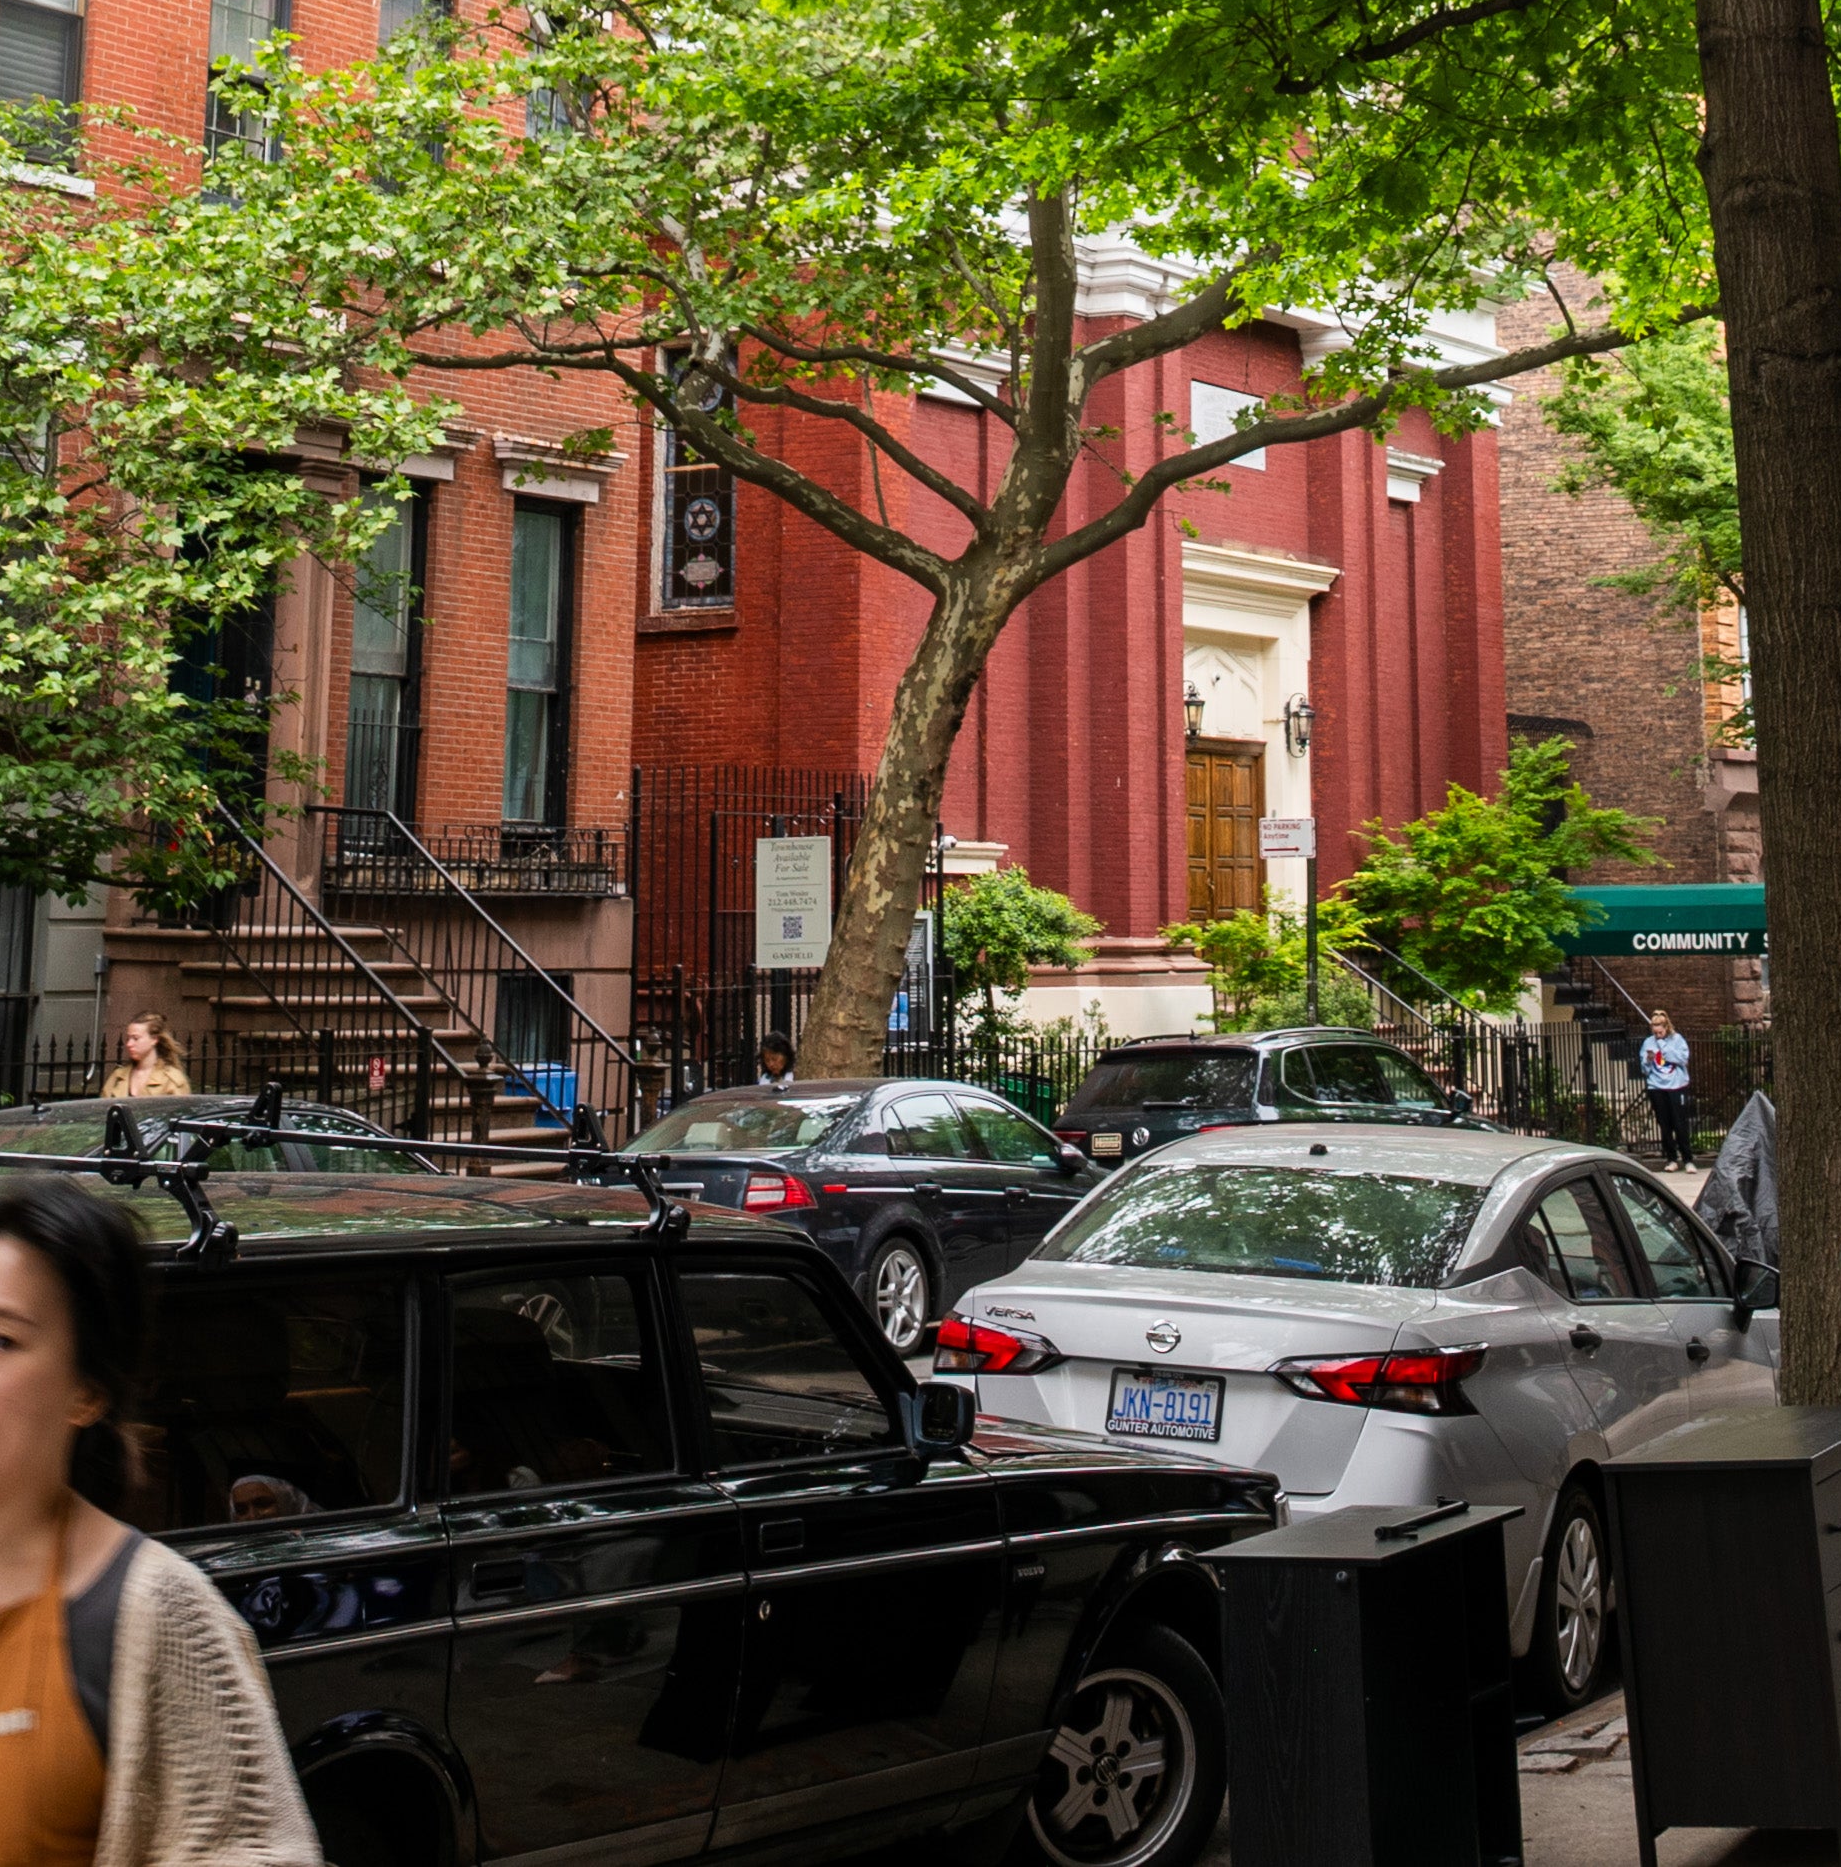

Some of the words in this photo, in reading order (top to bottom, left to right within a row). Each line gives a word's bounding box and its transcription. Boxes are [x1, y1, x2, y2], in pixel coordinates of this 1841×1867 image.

[1632, 933, 1749, 951] COMMUNITY
[984, 1305, 1036, 1322] VERSA
[1114, 1386, 1211, 1425] JKN-8191
[1107, 1420, 1149, 1434] GUNTER
[1150, 1423, 1216, 1440] AUTOMOTIVE
[1017, 1565, 1045, 1577] VOLVO
